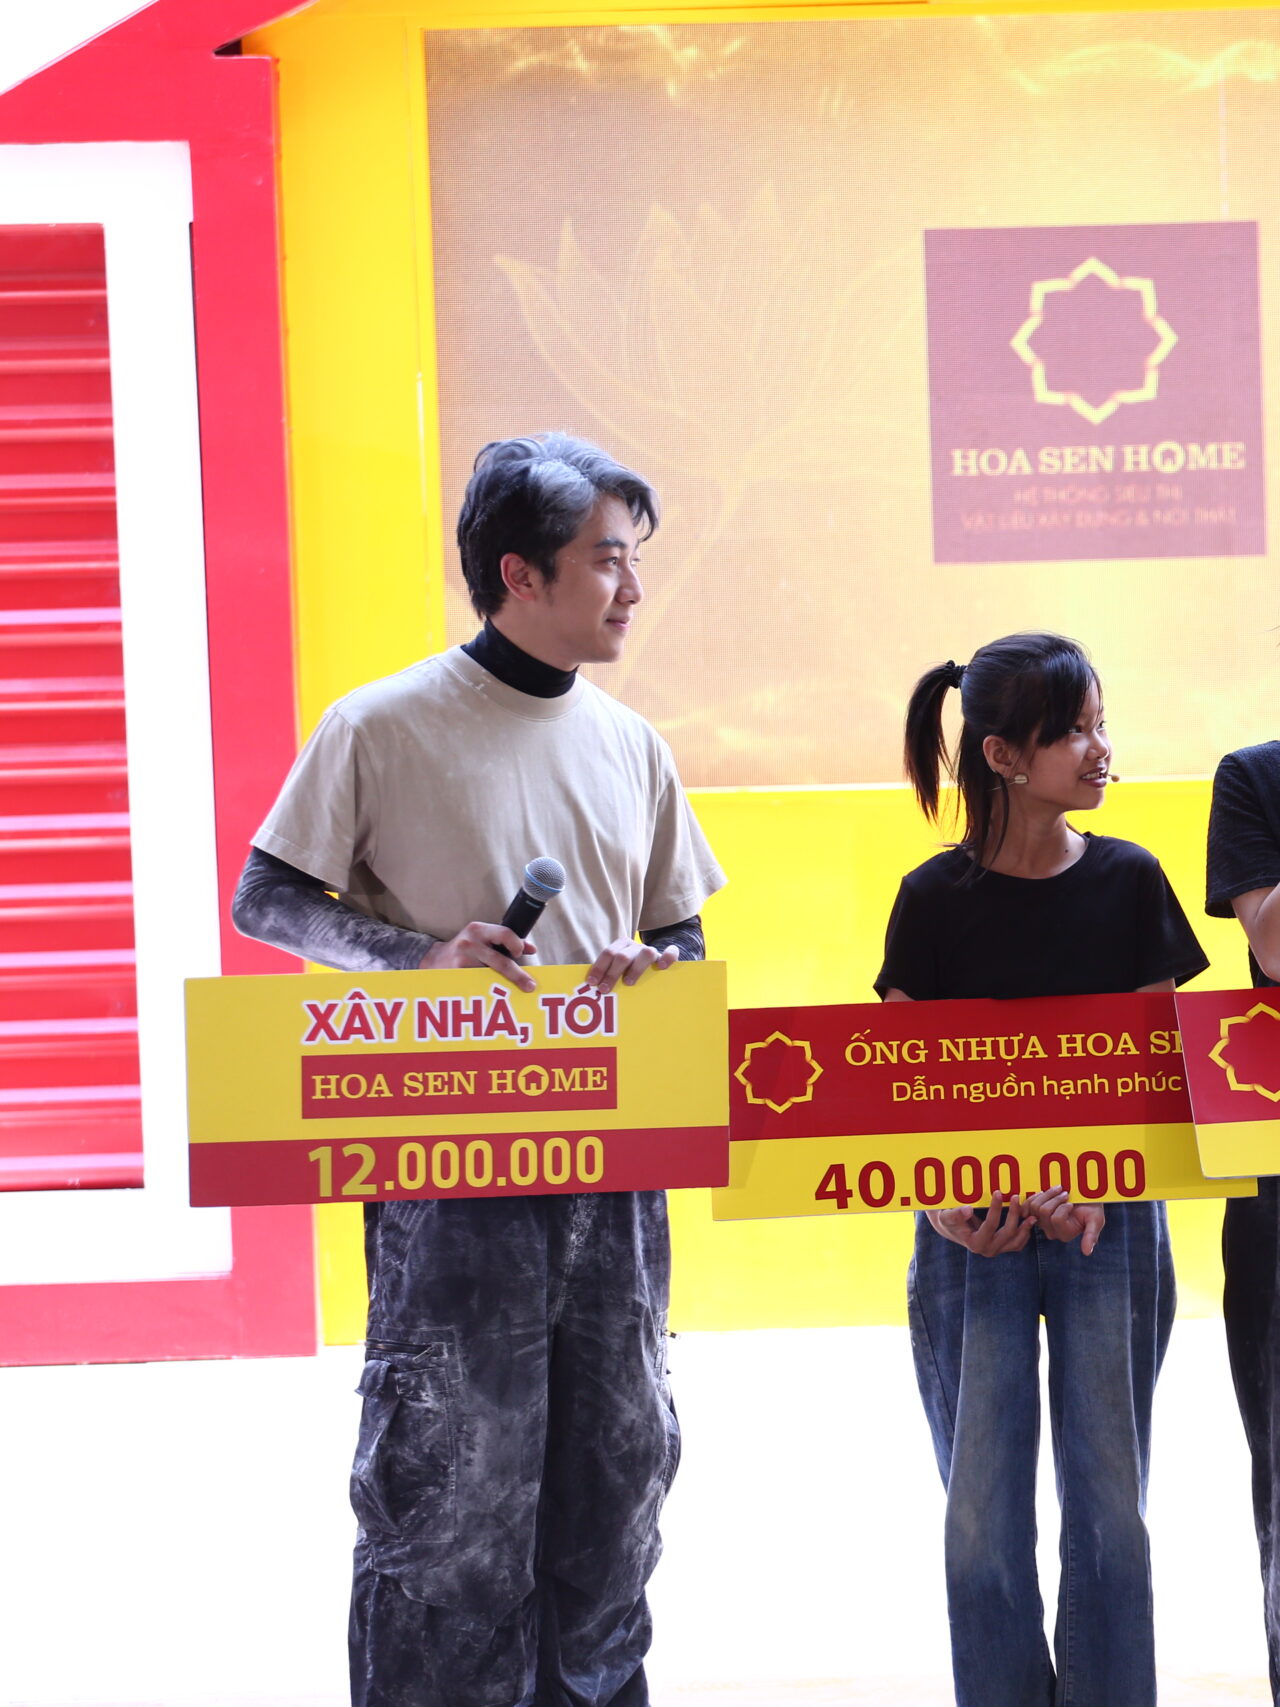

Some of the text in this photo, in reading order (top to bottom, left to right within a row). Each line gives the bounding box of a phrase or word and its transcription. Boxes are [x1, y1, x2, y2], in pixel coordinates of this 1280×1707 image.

[951, 441, 1246, 476] HOA SEN HOME
[305, 984, 615, 1043] XÂY NHÀ, TỚI
[844, 1029, 928, 1066] ỐNG
[939, 1033, 1048, 1067] NHỰA
[1057, 1032, 1140, 1058] HOA
[312, 1064, 607, 1099] HOA SEN HOME
[893, 1070, 1182, 1103] Dẫn nguồn hạnh phúc
[308, 1136, 604, 1197] 12.000.000
[814, 1149, 1146, 1210] 40.000.000
